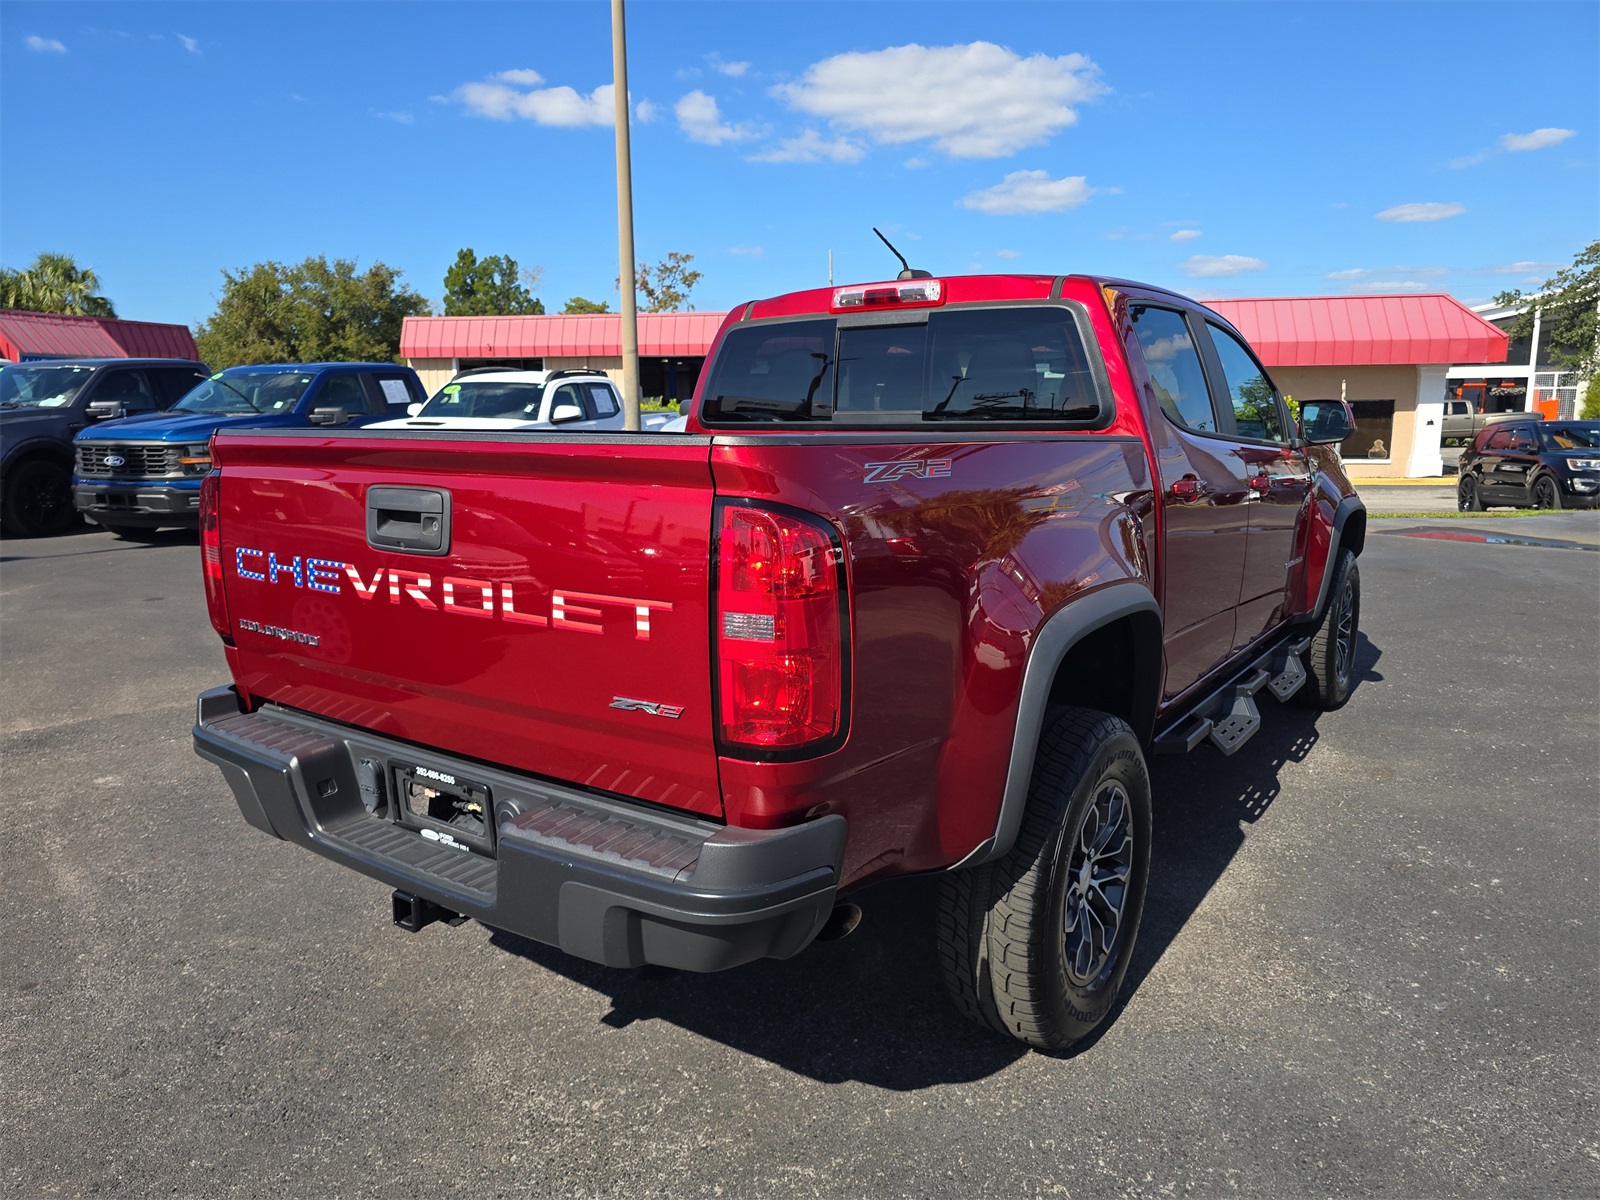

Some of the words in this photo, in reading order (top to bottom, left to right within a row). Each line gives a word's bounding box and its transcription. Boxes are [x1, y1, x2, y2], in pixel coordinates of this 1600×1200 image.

[863, 458, 952, 483] ZR2
[236, 547, 673, 640] CHEVROLET
[239, 618, 320, 646] COLORADO
[609, 695, 686, 719] ZR2
